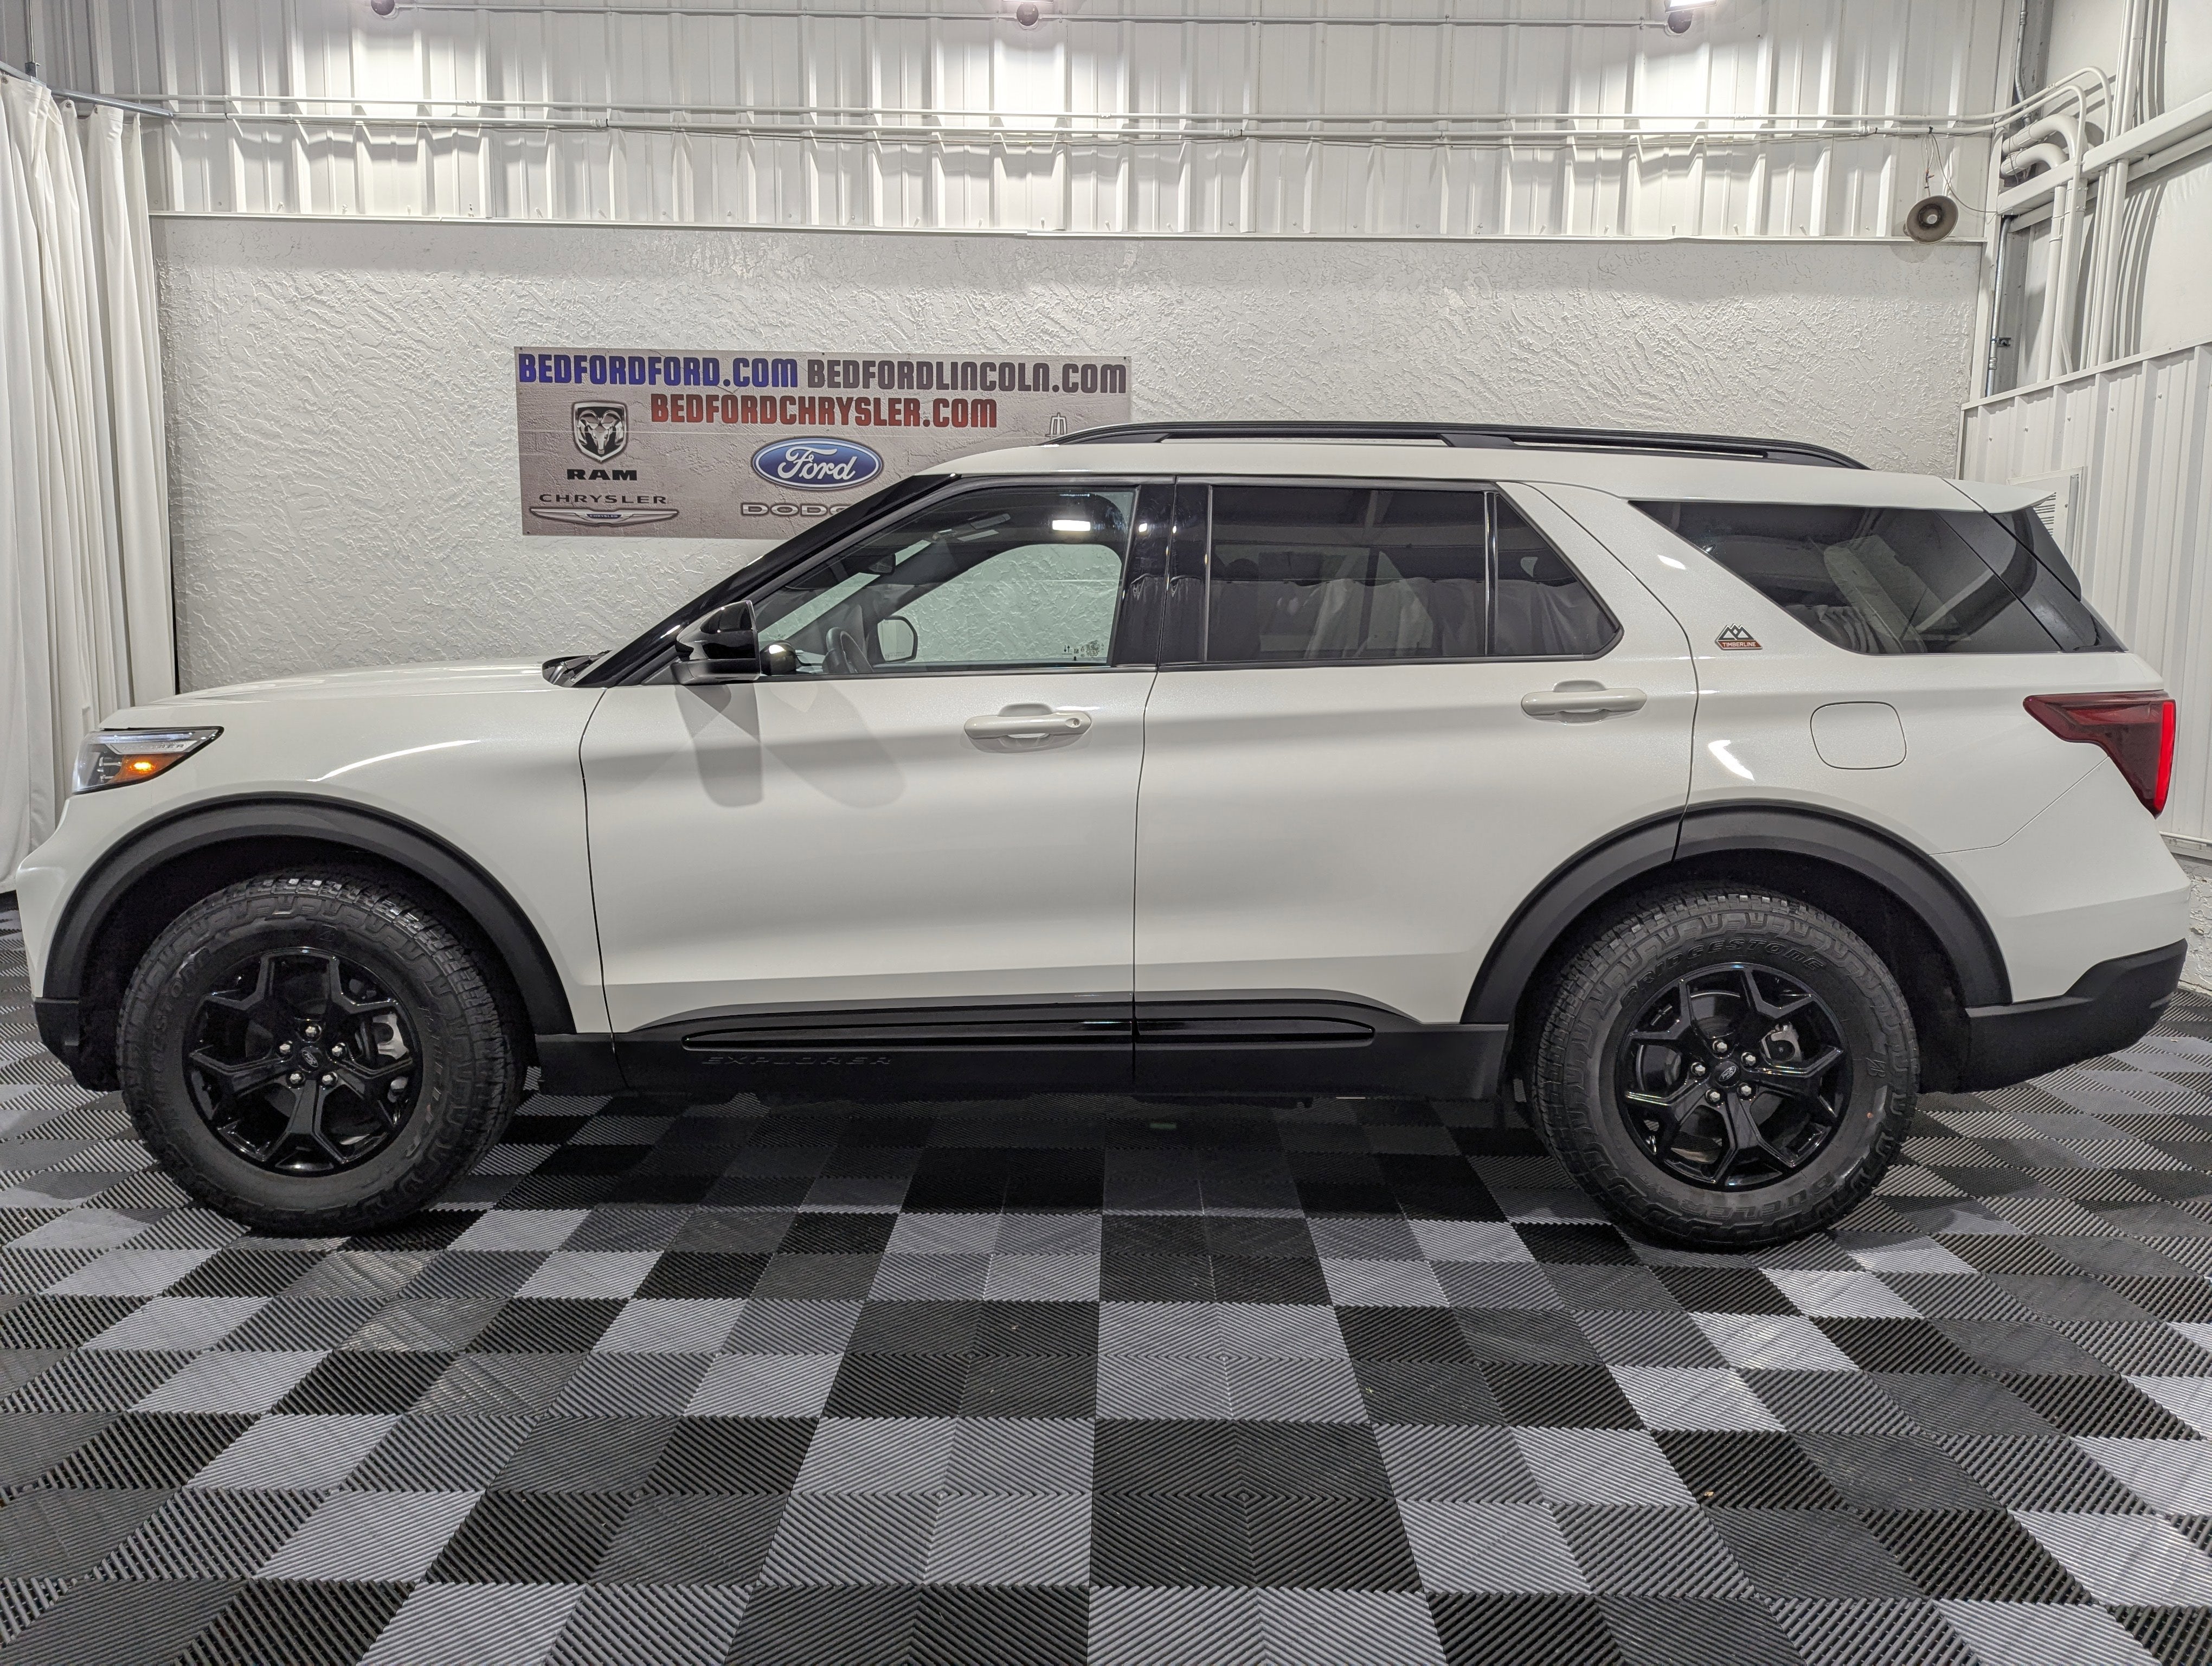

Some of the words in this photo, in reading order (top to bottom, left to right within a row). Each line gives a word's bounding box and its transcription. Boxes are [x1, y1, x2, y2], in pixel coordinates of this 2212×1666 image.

[518, 354, 798, 388] BEDFORDFORD.COM
[807, 359, 1127, 394] BEDFORDLINCOLN.COM
[651, 393, 997, 428] BEDFORDCHRYSLER.COM
[567, 469, 638, 481] RAM
[777, 446, 858, 480] Ford
[539, 494, 667, 504] CHRYSLER
[1620, 937, 1825, 1008] BRIDGESTONE
